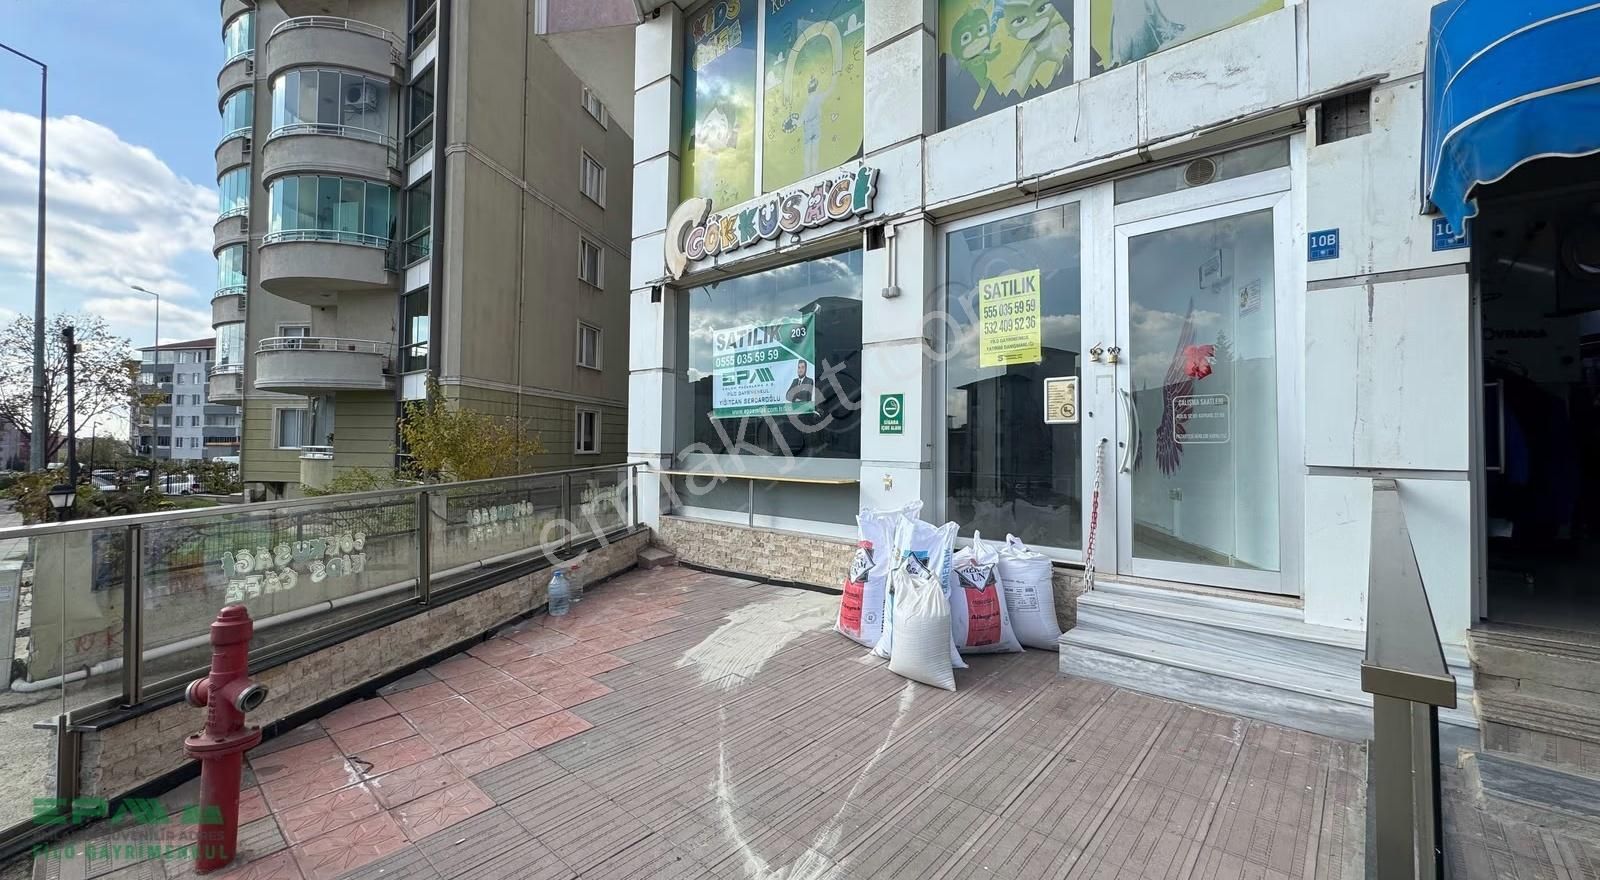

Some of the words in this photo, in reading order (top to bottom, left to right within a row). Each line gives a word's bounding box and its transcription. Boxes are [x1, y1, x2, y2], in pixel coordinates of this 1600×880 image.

[1311, 234, 1336, 248] 10B
[983, 275, 1036, 300] SATILIK
[984, 306, 998, 319] 555
[999, 304, 1012, 318] 035
[1014, 302, 1024, 316] 59
[1025, 298, 1036, 313] 59
[791, 327, 807, 338] 203
[984, 321, 998, 335] 532
[999, 318, 1013, 333] 409
[1014, 317, 1024, 331] 52
[1025, 315, 1036, 329] 36
[716, 325, 782, 351] SATILIK
[715, 353, 735, 368] 0555
[736, 353, 752, 365] 035
[755, 351, 765, 363] 59
[768, 348, 779, 361] 59
[971, 572, 987, 582] UN
